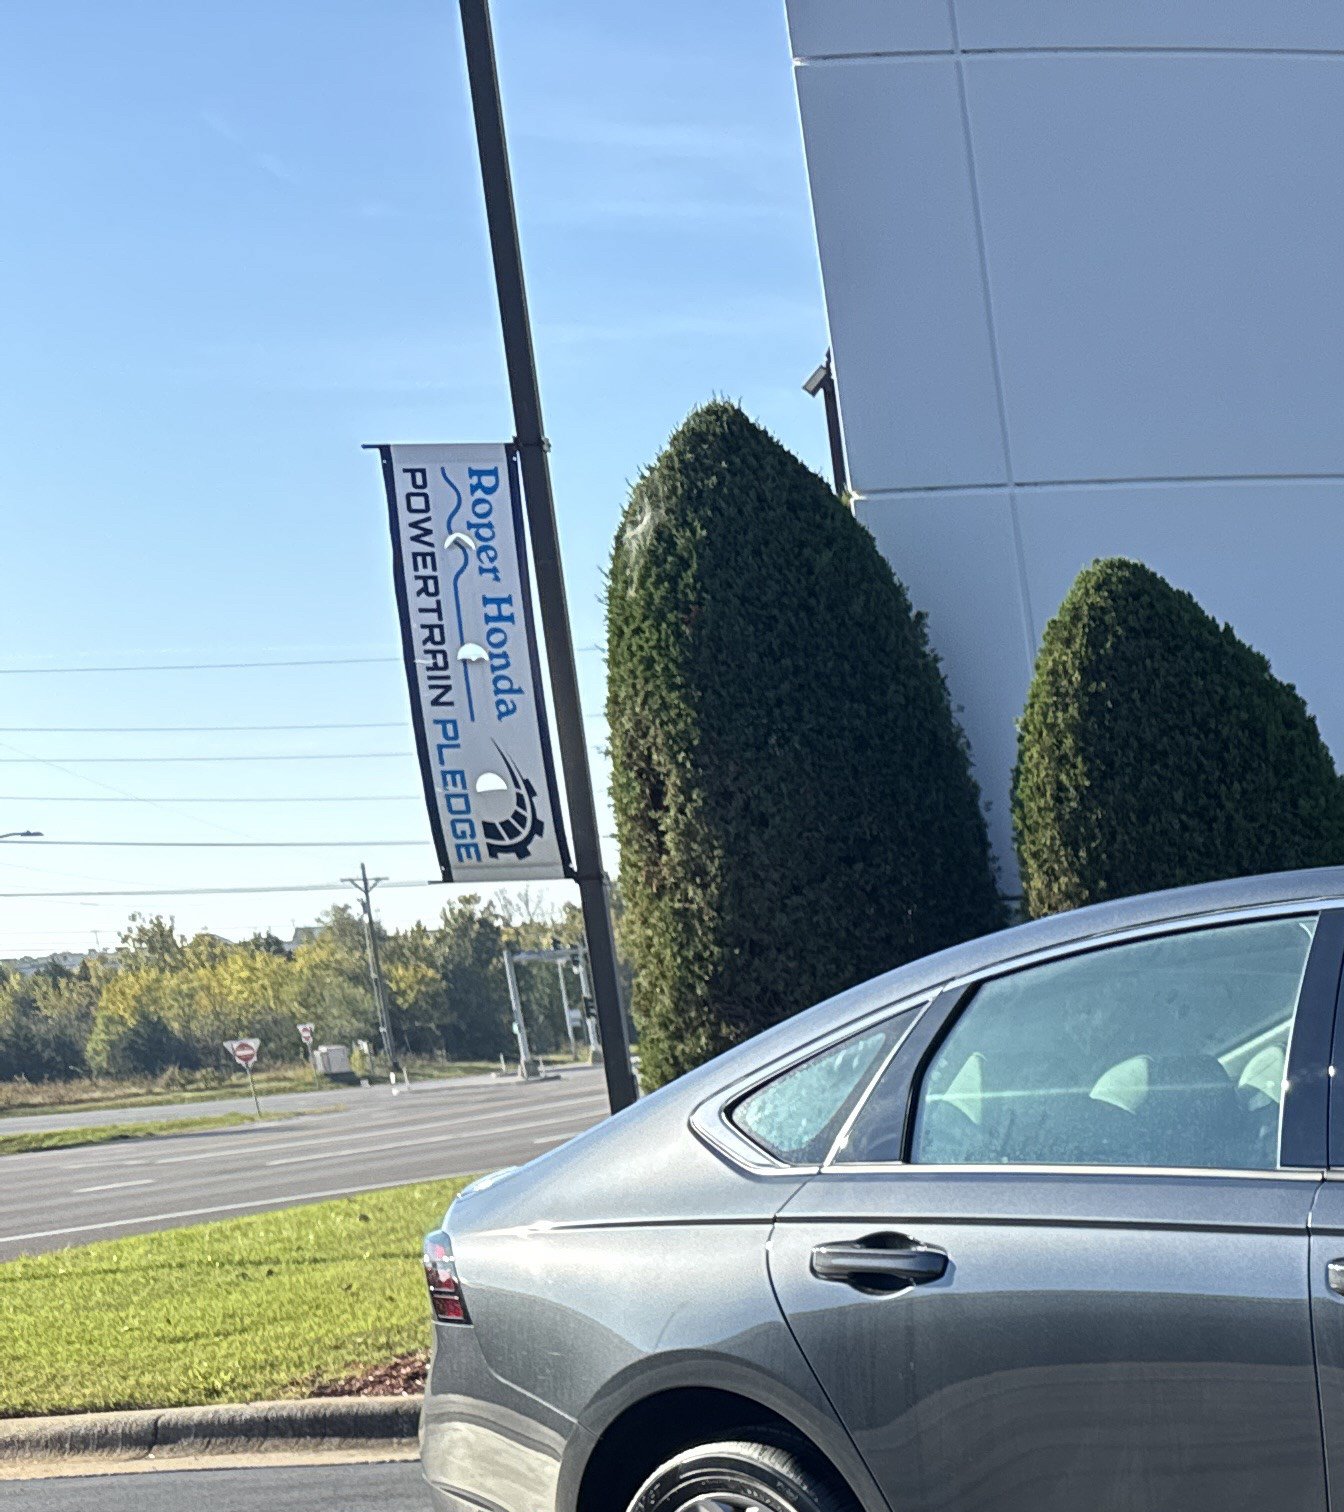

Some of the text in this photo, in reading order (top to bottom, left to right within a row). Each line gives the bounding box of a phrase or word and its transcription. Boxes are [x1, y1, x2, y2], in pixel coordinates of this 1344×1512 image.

[402, 467, 482, 864] POWERTRAIN PLEDGE
[467, 466, 525, 721] Roper Honda
